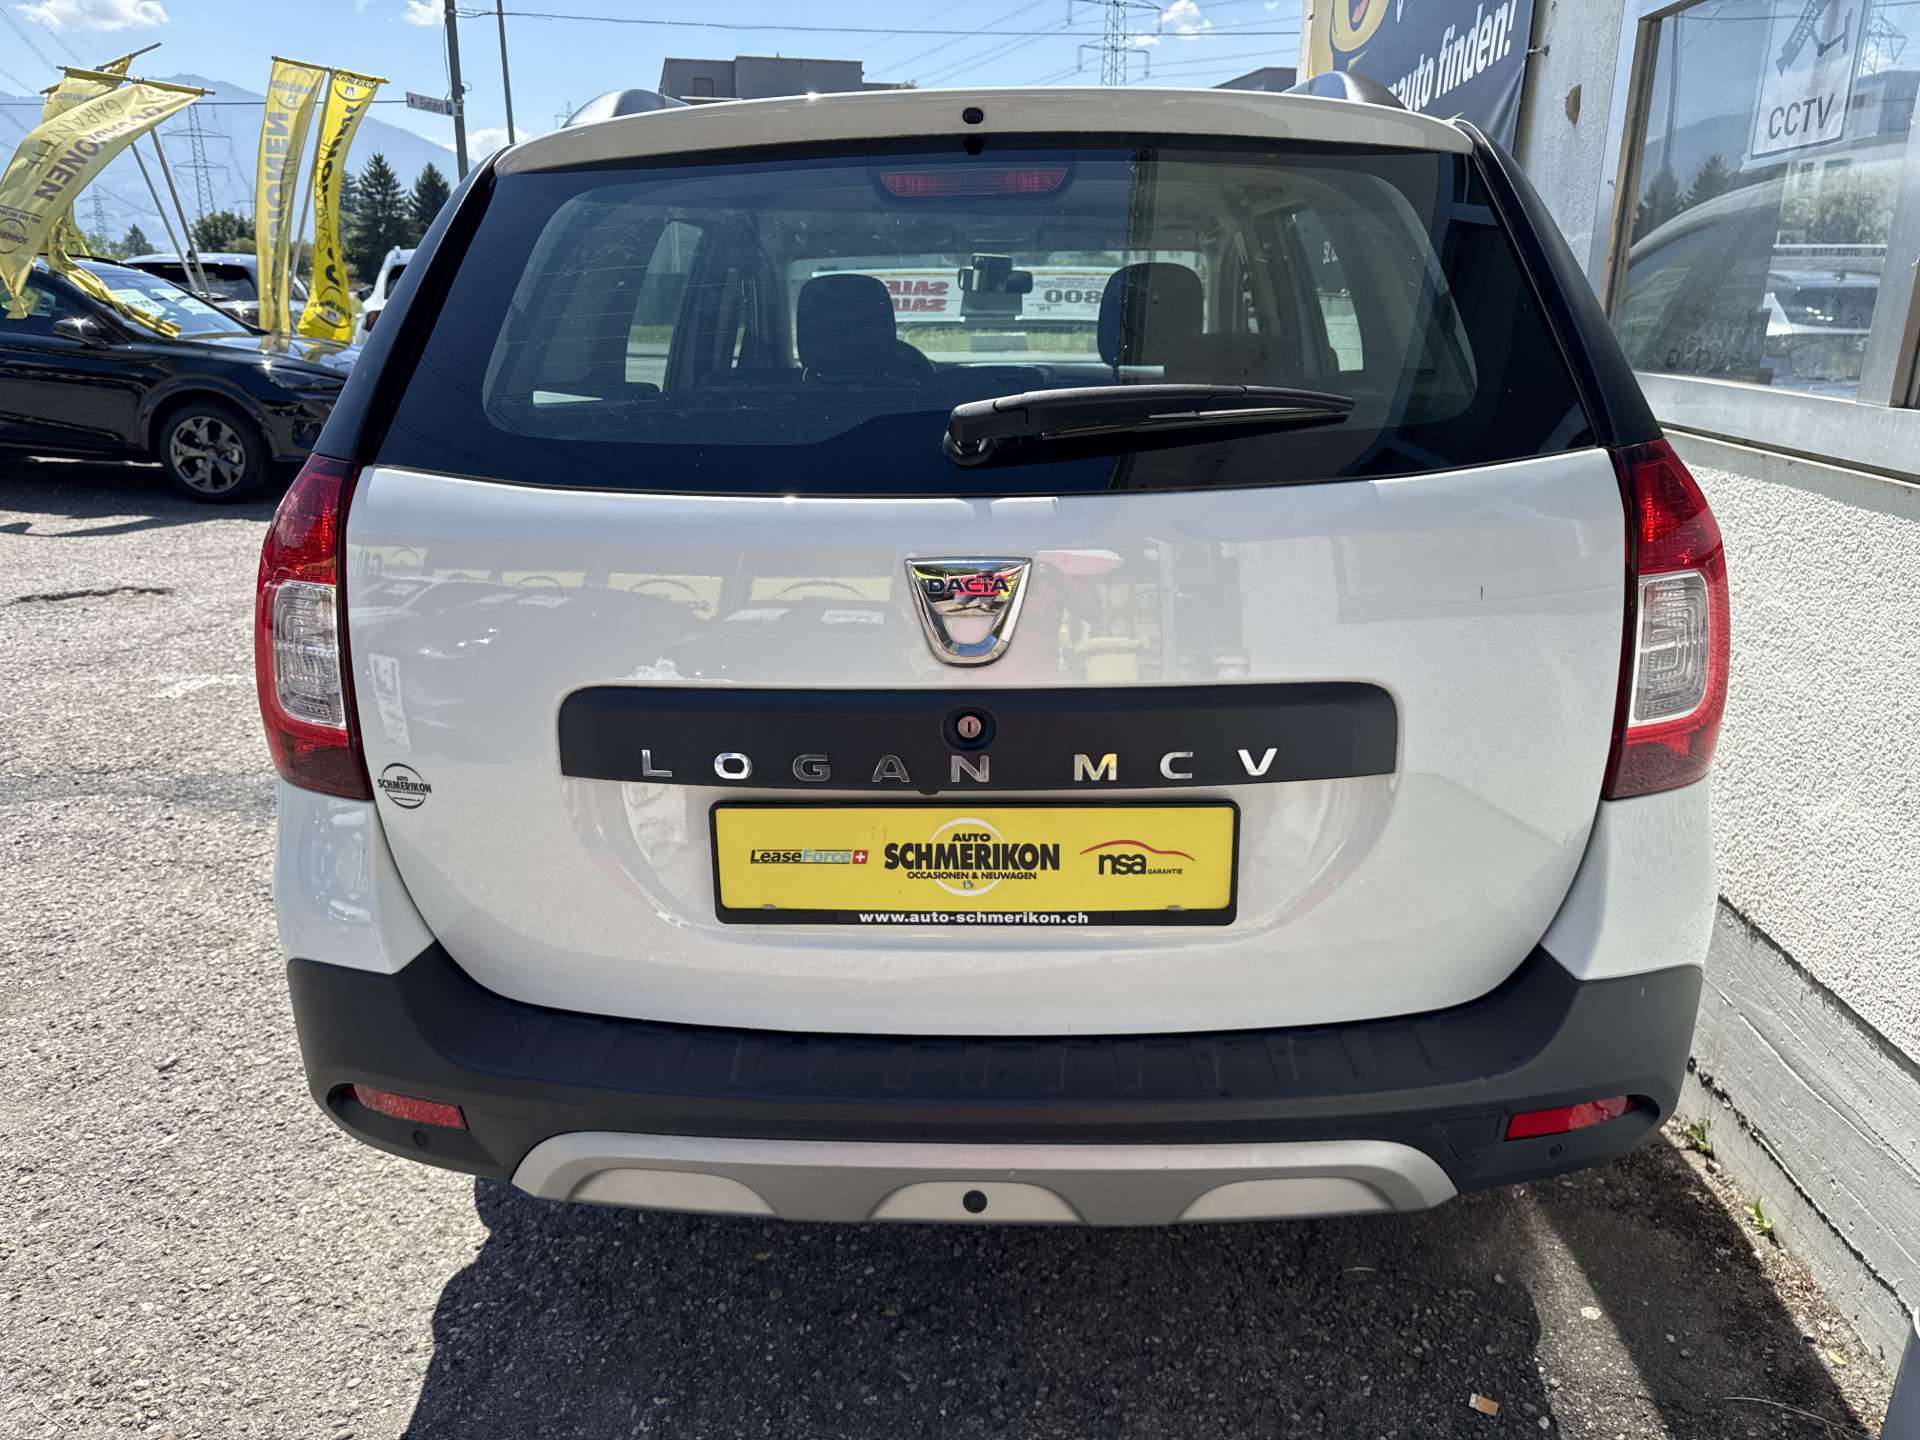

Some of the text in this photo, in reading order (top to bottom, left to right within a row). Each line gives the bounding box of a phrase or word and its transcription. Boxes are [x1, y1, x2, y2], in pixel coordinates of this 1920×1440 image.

[1434, 0, 1517, 99] finden!
[1769, 93, 1835, 139] CCTV
[28, 99, 125, 172] GARANTIE
[927, 575, 1010, 594] DACIA
[641, 747, 1278, 783] LOGAN MCV
[378, 779, 432, 793] SCHMERIKON
[952, 833, 991, 842] AUTO
[750, 849, 851, 863] LeaseForce
[884, 843, 1060, 870] SCHMERIKON
[1098, 854, 1147, 875] nsa
[907, 871, 1037, 880] OCCASIONEN & NEUWAGEN
[859, 911, 1089, 924] www.auto-schmerikon.ch
